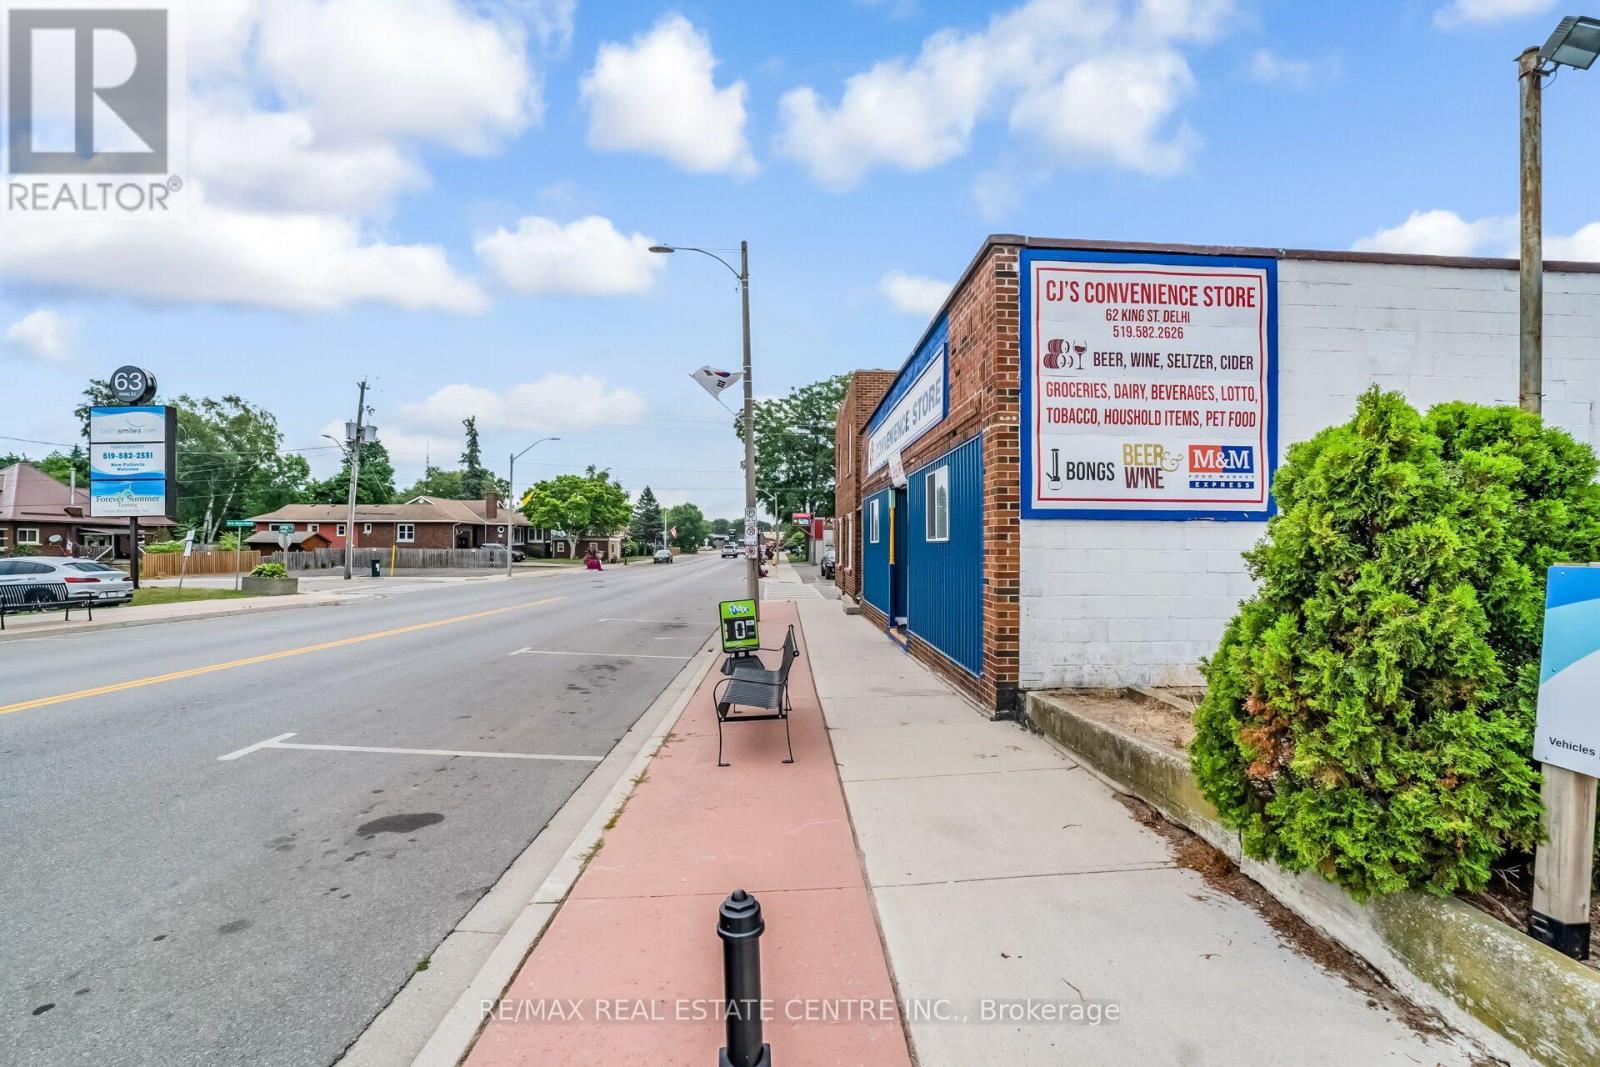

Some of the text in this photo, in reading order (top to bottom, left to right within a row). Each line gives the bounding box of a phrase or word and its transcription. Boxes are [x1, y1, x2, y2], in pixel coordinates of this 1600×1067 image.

[1046, 280, 1256, 308] CJ'S CONVENIENCE STORE
[1105, 308, 1190, 323] 62 KING ST. DELHI
[1112, 325, 1184, 339] 519.582.2626
[1093, 352, 1254, 372] BEER, WINE, SELTZER, CIDER
[114, 372, 142, 391] 63
[912, 376, 942, 426] STORE
[1046, 381, 1258, 404] GROCERIES, DAIRY, BEVERAGES, LOTTO,
[1046, 407, 1256, 428] TOBACCO, HOUSHOLD ITEMS, PET FOOD
[1122, 443, 1185, 473] BEER &
[1192, 449, 1250, 469] M&M
[1066, 461, 1116, 482] BONGS
[1124, 466, 1165, 489] WINE
[1194, 481, 1251, 489] EXPRESS
[96, 494, 160, 503] Forever Summer
[1549, 736, 1596, 757] Vehicles
